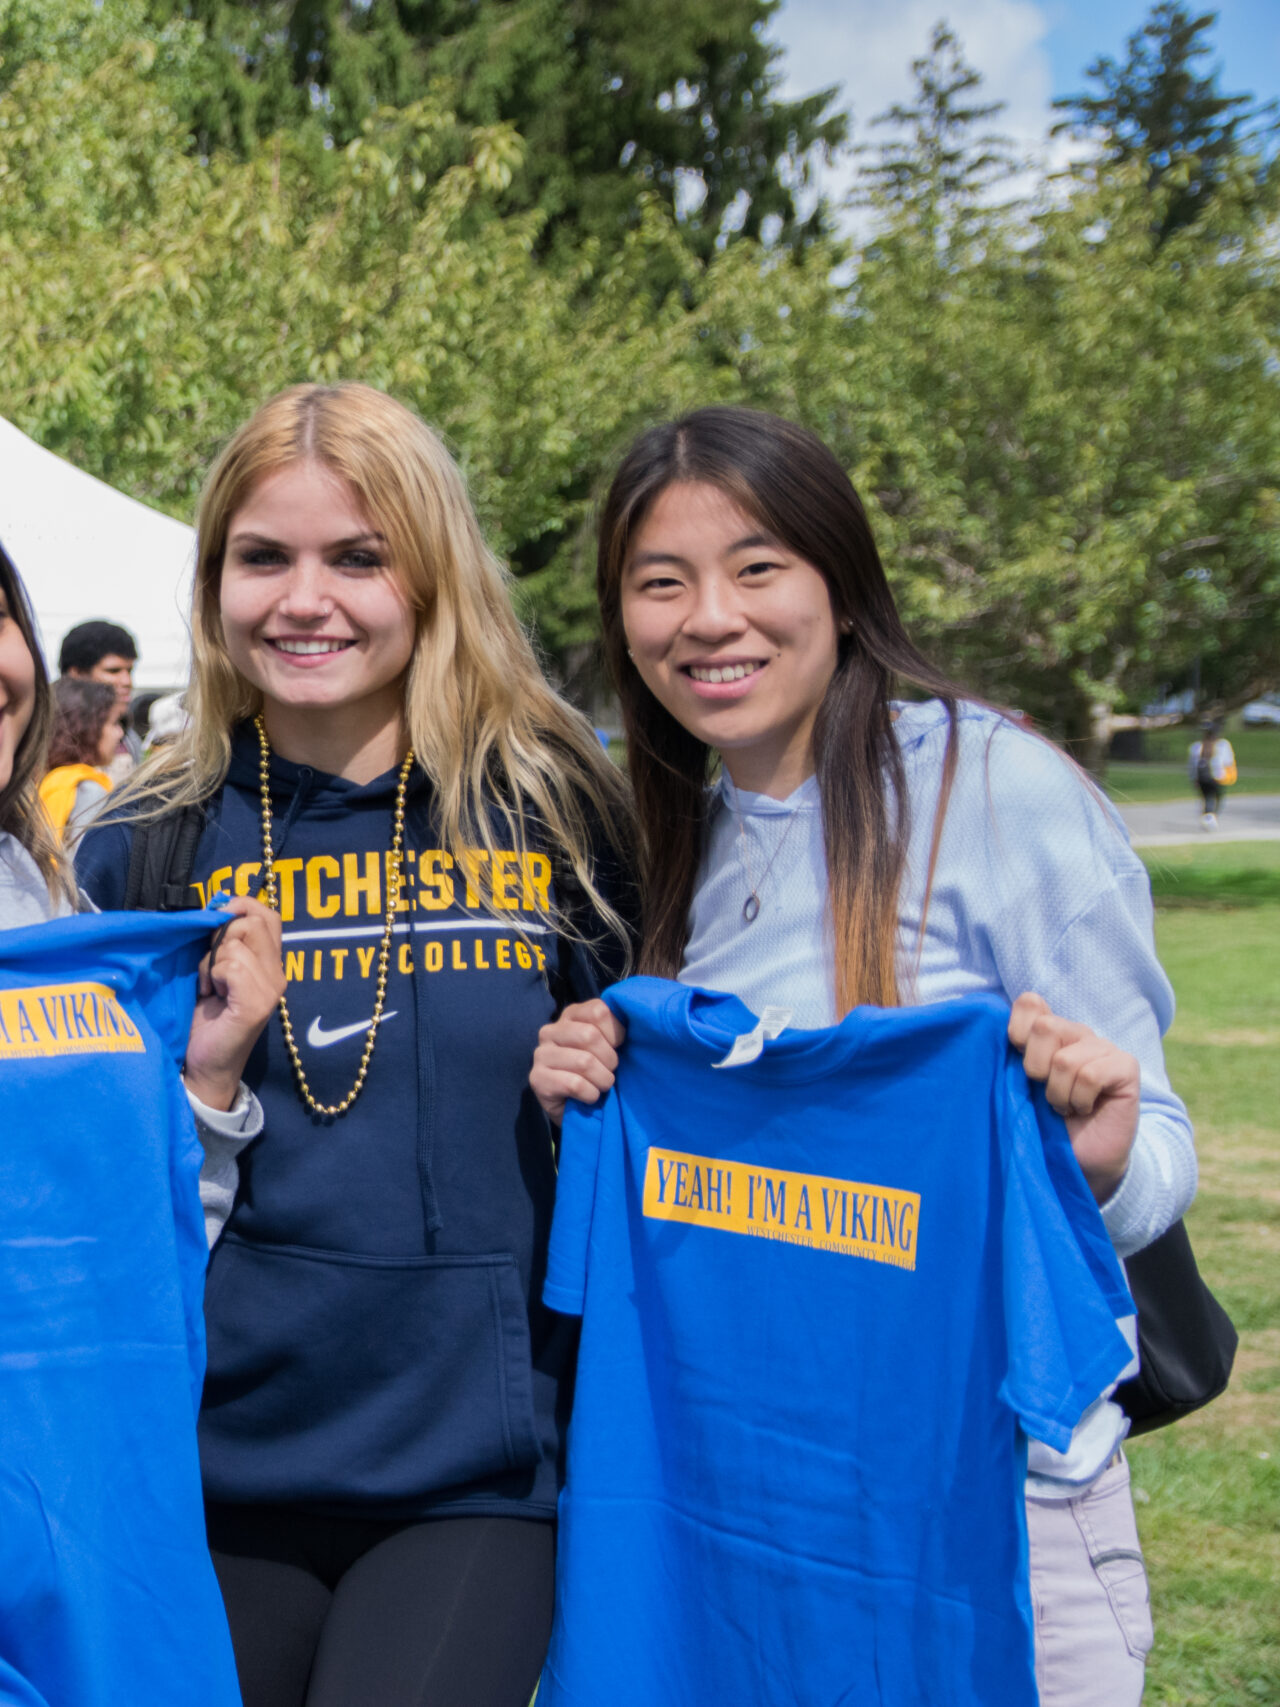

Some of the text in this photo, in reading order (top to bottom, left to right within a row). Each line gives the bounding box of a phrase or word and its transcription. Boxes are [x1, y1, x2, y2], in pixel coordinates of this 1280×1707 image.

[398, 938, 547, 975] COLLEGE
[17, 998, 41, 1044] A
[656, 1158, 914, 1252] YEAH! I'M A VIKING
[746, 1225, 814, 1249] WESTCHESTER
[820, 1239, 877, 1263] COMMUNITY
